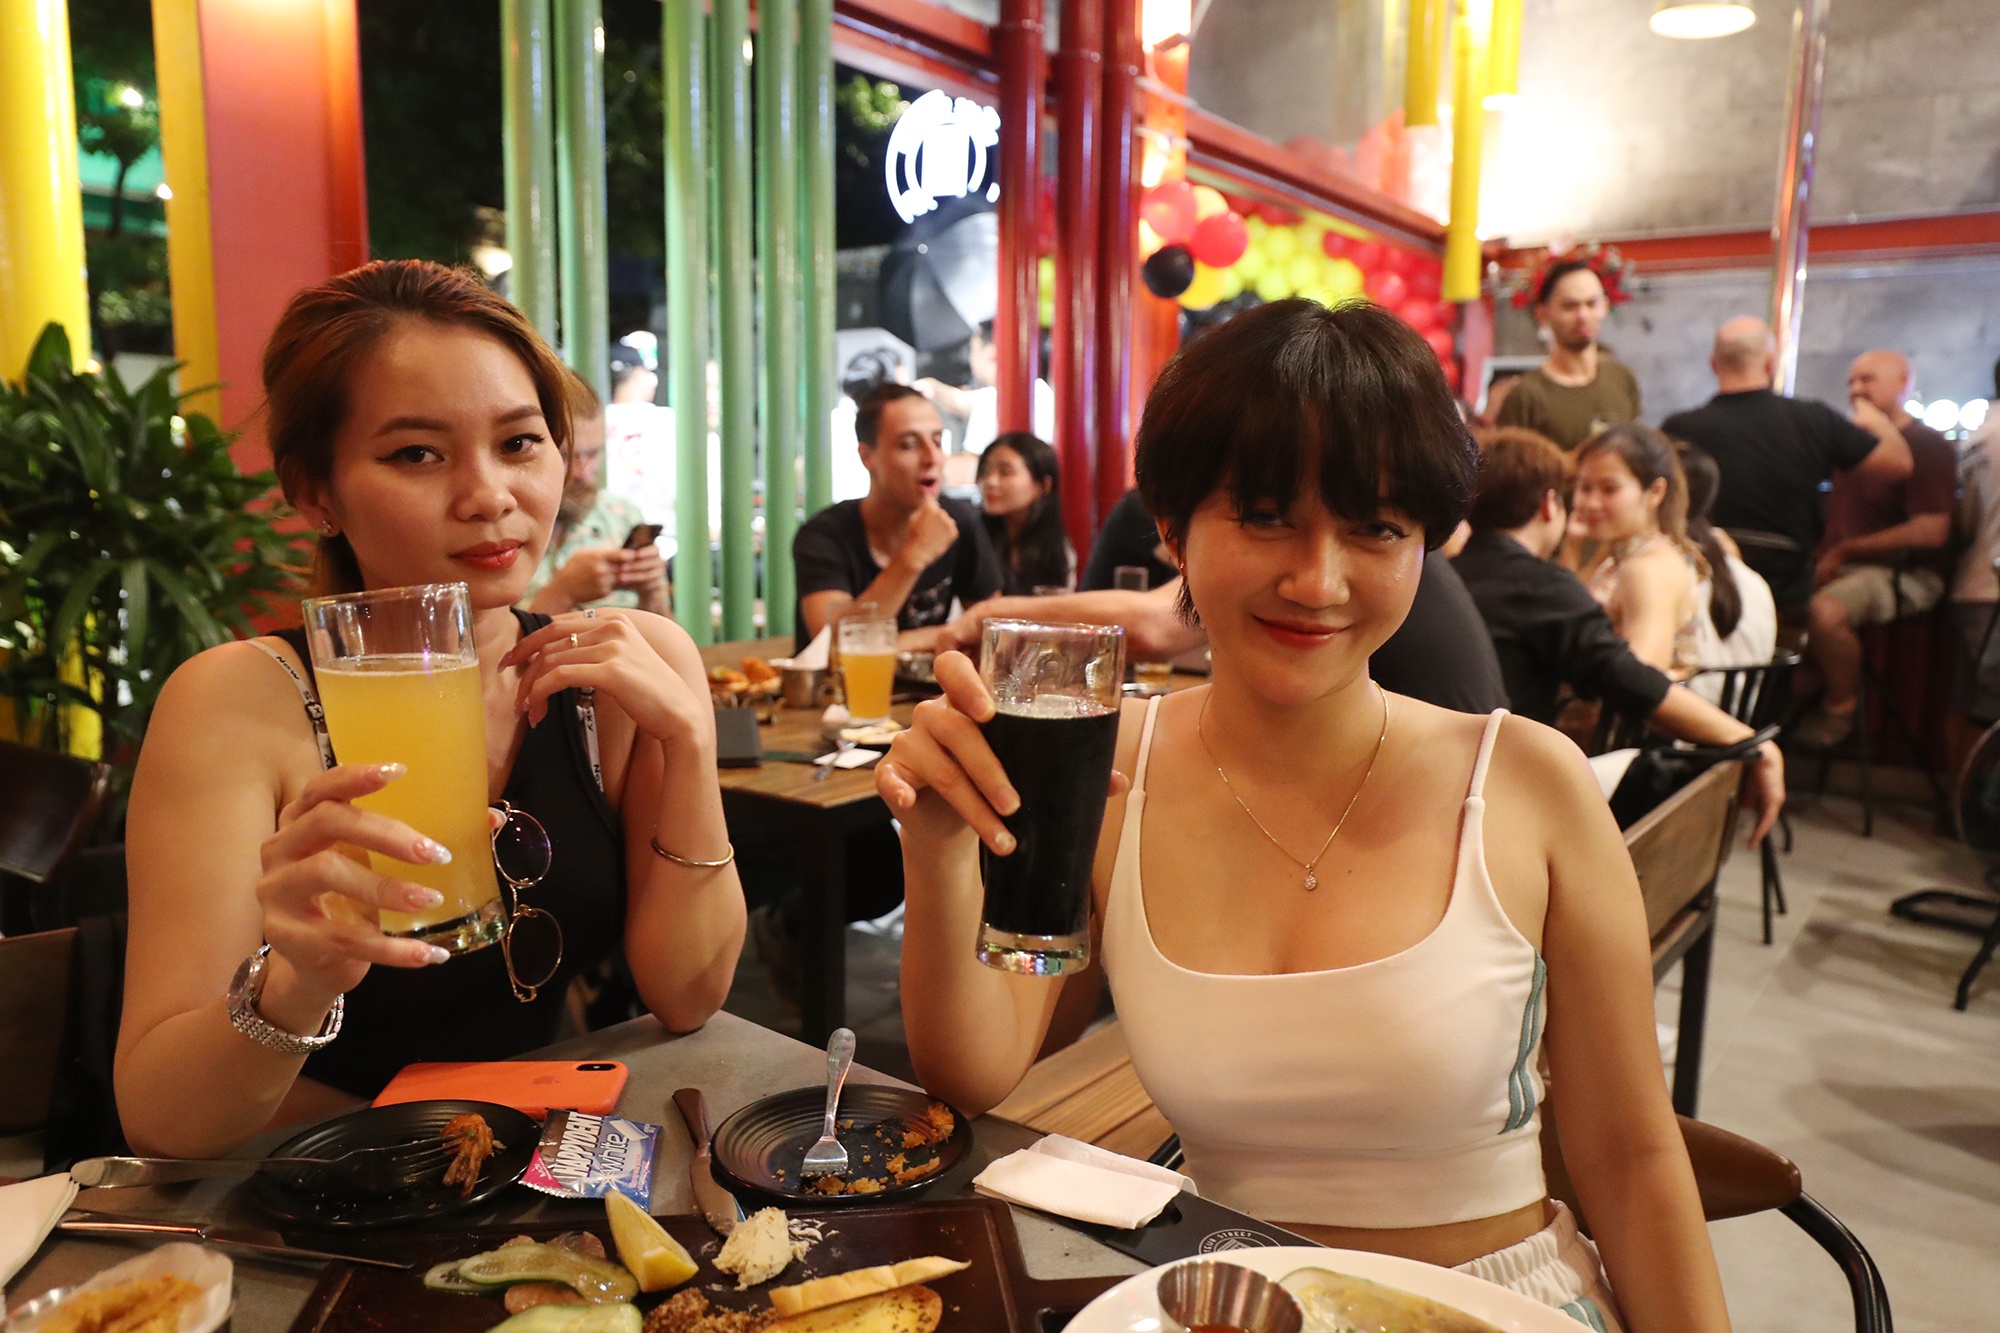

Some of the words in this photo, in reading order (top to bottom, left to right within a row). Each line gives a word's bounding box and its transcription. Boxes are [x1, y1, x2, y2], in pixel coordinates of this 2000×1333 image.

[551, 1111, 604, 1178] HAPPYDENT
[598, 1133, 629, 1172] white
[1217, 1231, 1252, 1239] STREET
